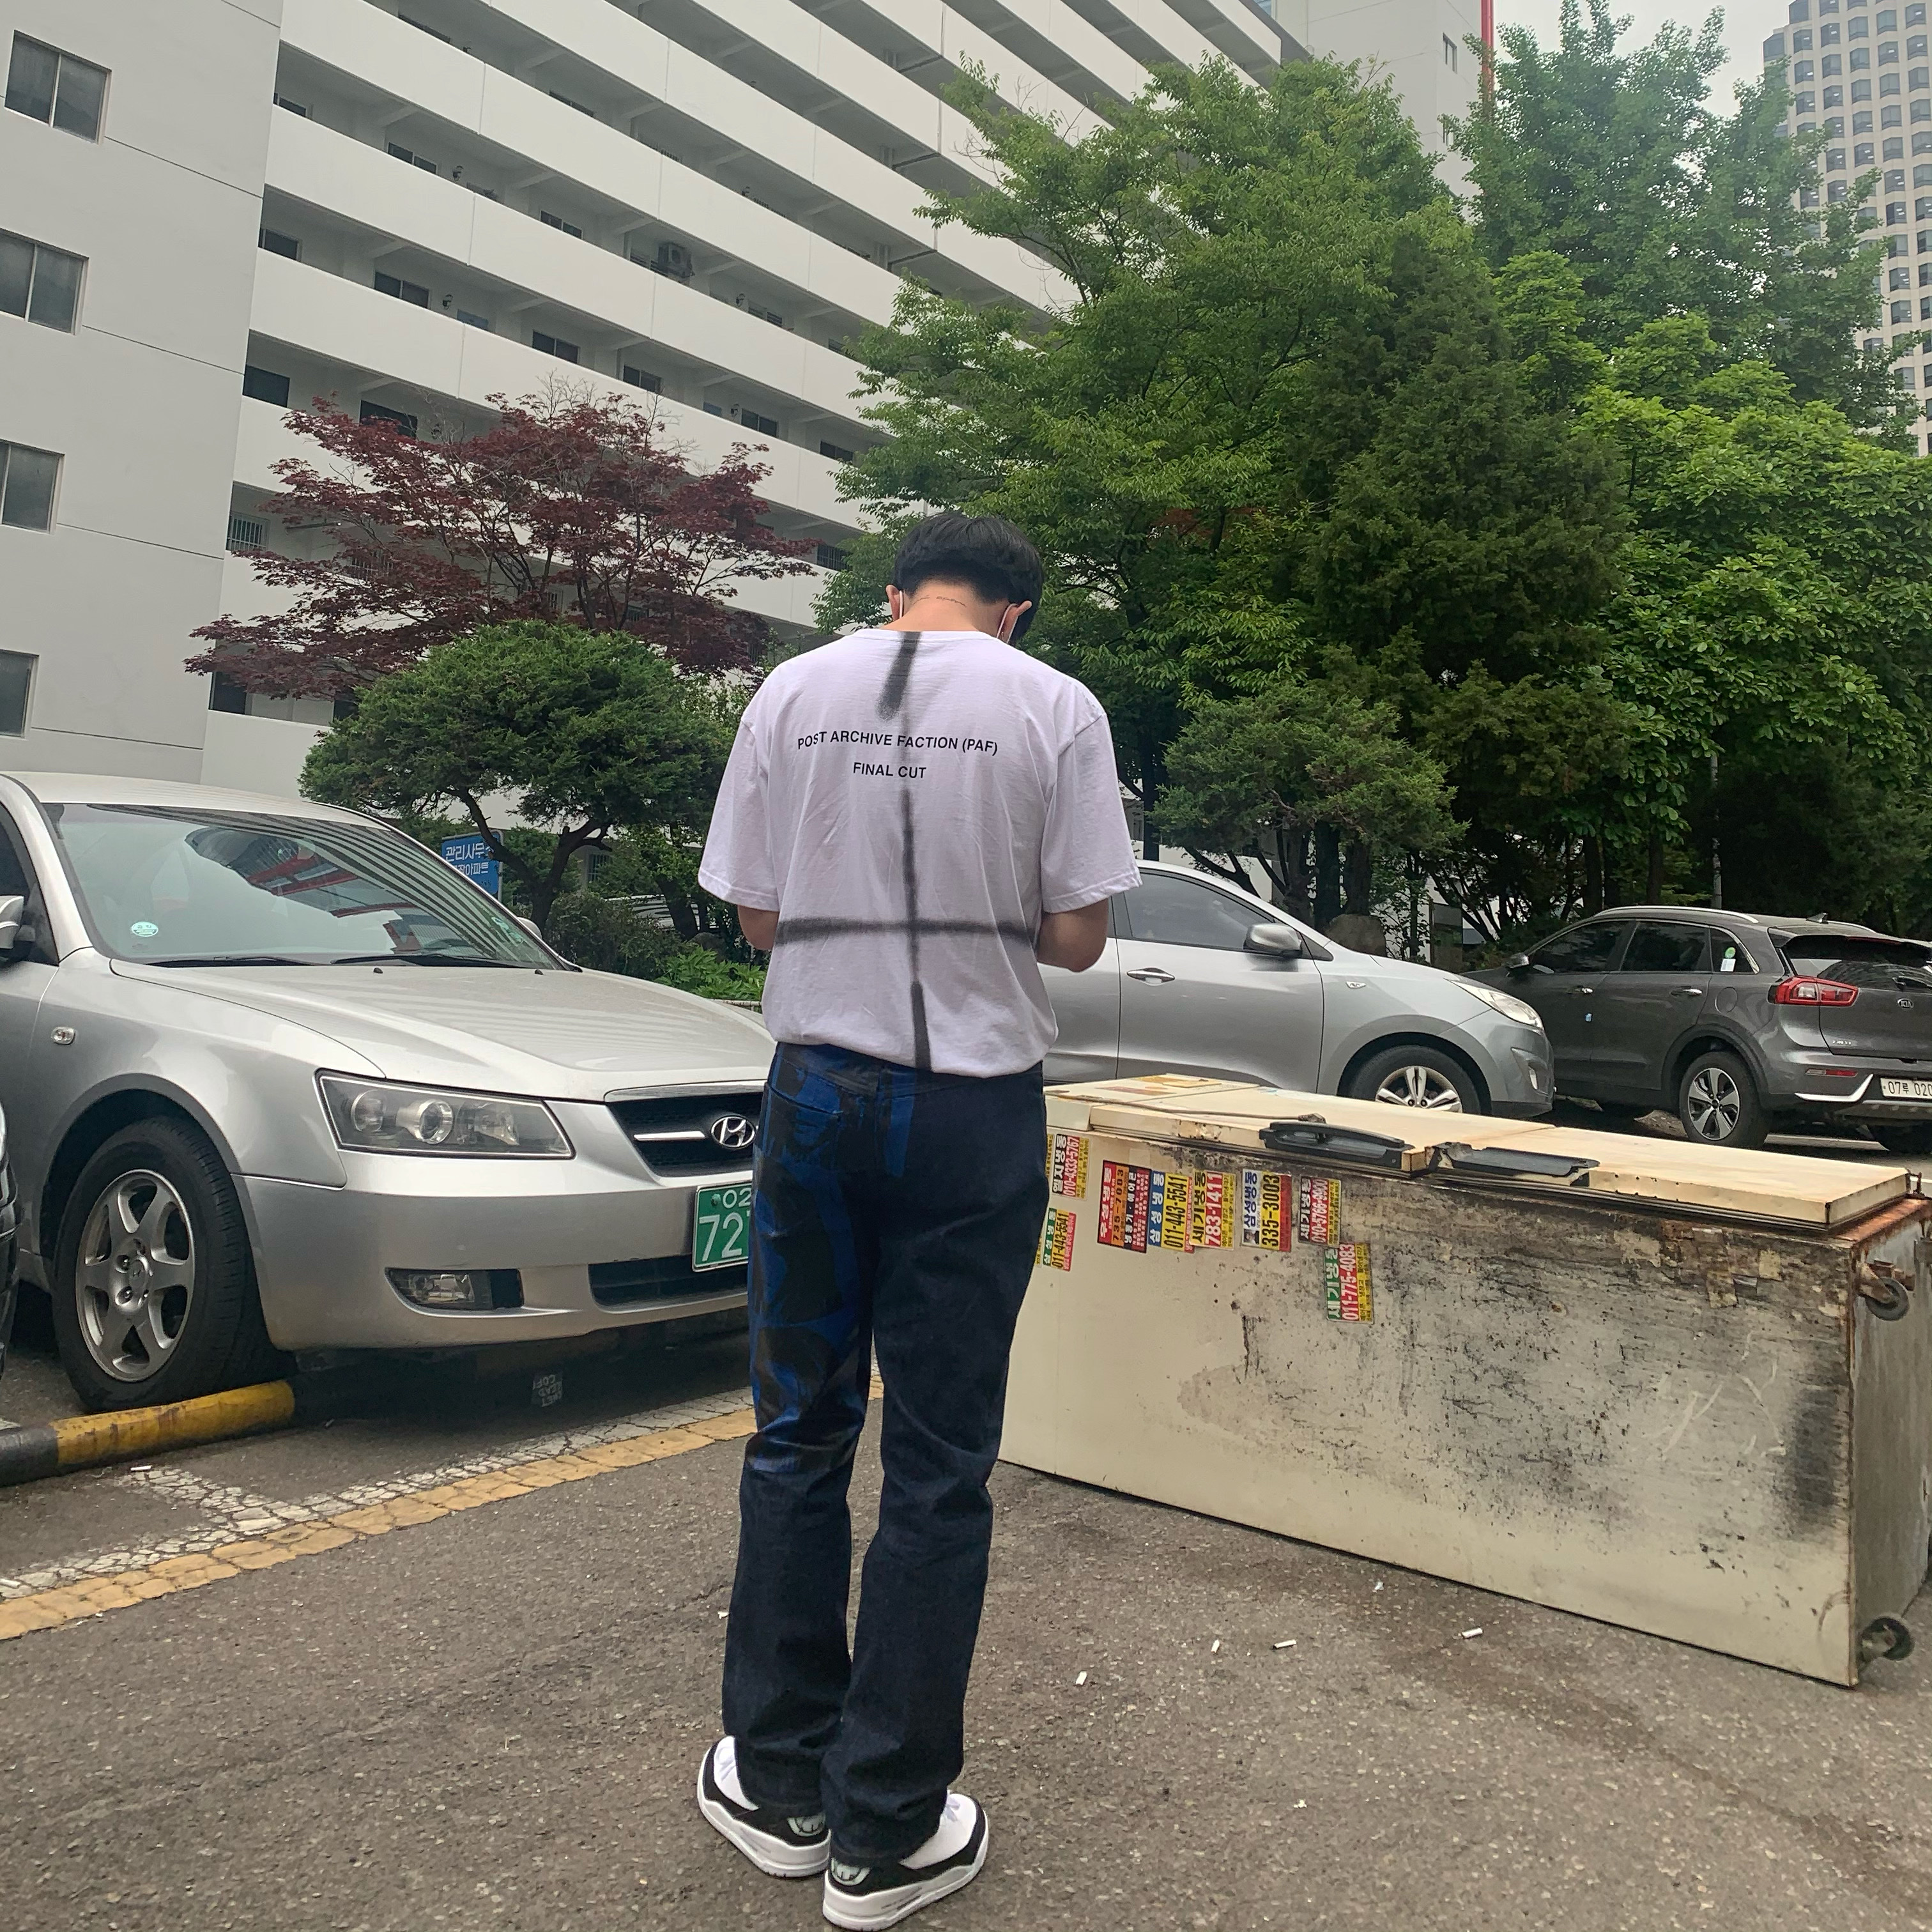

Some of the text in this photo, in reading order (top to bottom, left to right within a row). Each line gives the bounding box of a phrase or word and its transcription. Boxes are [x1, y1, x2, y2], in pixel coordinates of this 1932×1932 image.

[798, 730, 998, 756] POST ARCHIVE FACTION (PAF)
[853, 762, 927, 779] FINAL CUT
[1887, 1080, 1910, 1095] 07루
[1063, 1137, 1079, 1196] 010-4333-5767
[1149, 1173, 1164, 1243] 삼성냉동
[1164, 1176, 1188, 1248] 011-443-5541
[1192, 1172, 1206, 1243] 세기냉동
[1206, 1173, 1222, 1245] 783-1411
[1243, 1172, 1257, 1228] 삼성냉동
[1261, 1175, 1280, 1247] 335-3003
[699, 1210, 751, 1262] 72
[1052, 1213, 1069, 1268] 011-443-5541
[1325, 1248, 1340, 1318] 세기냉동
[1339, 1243, 1359, 1320] 011-775-4083
